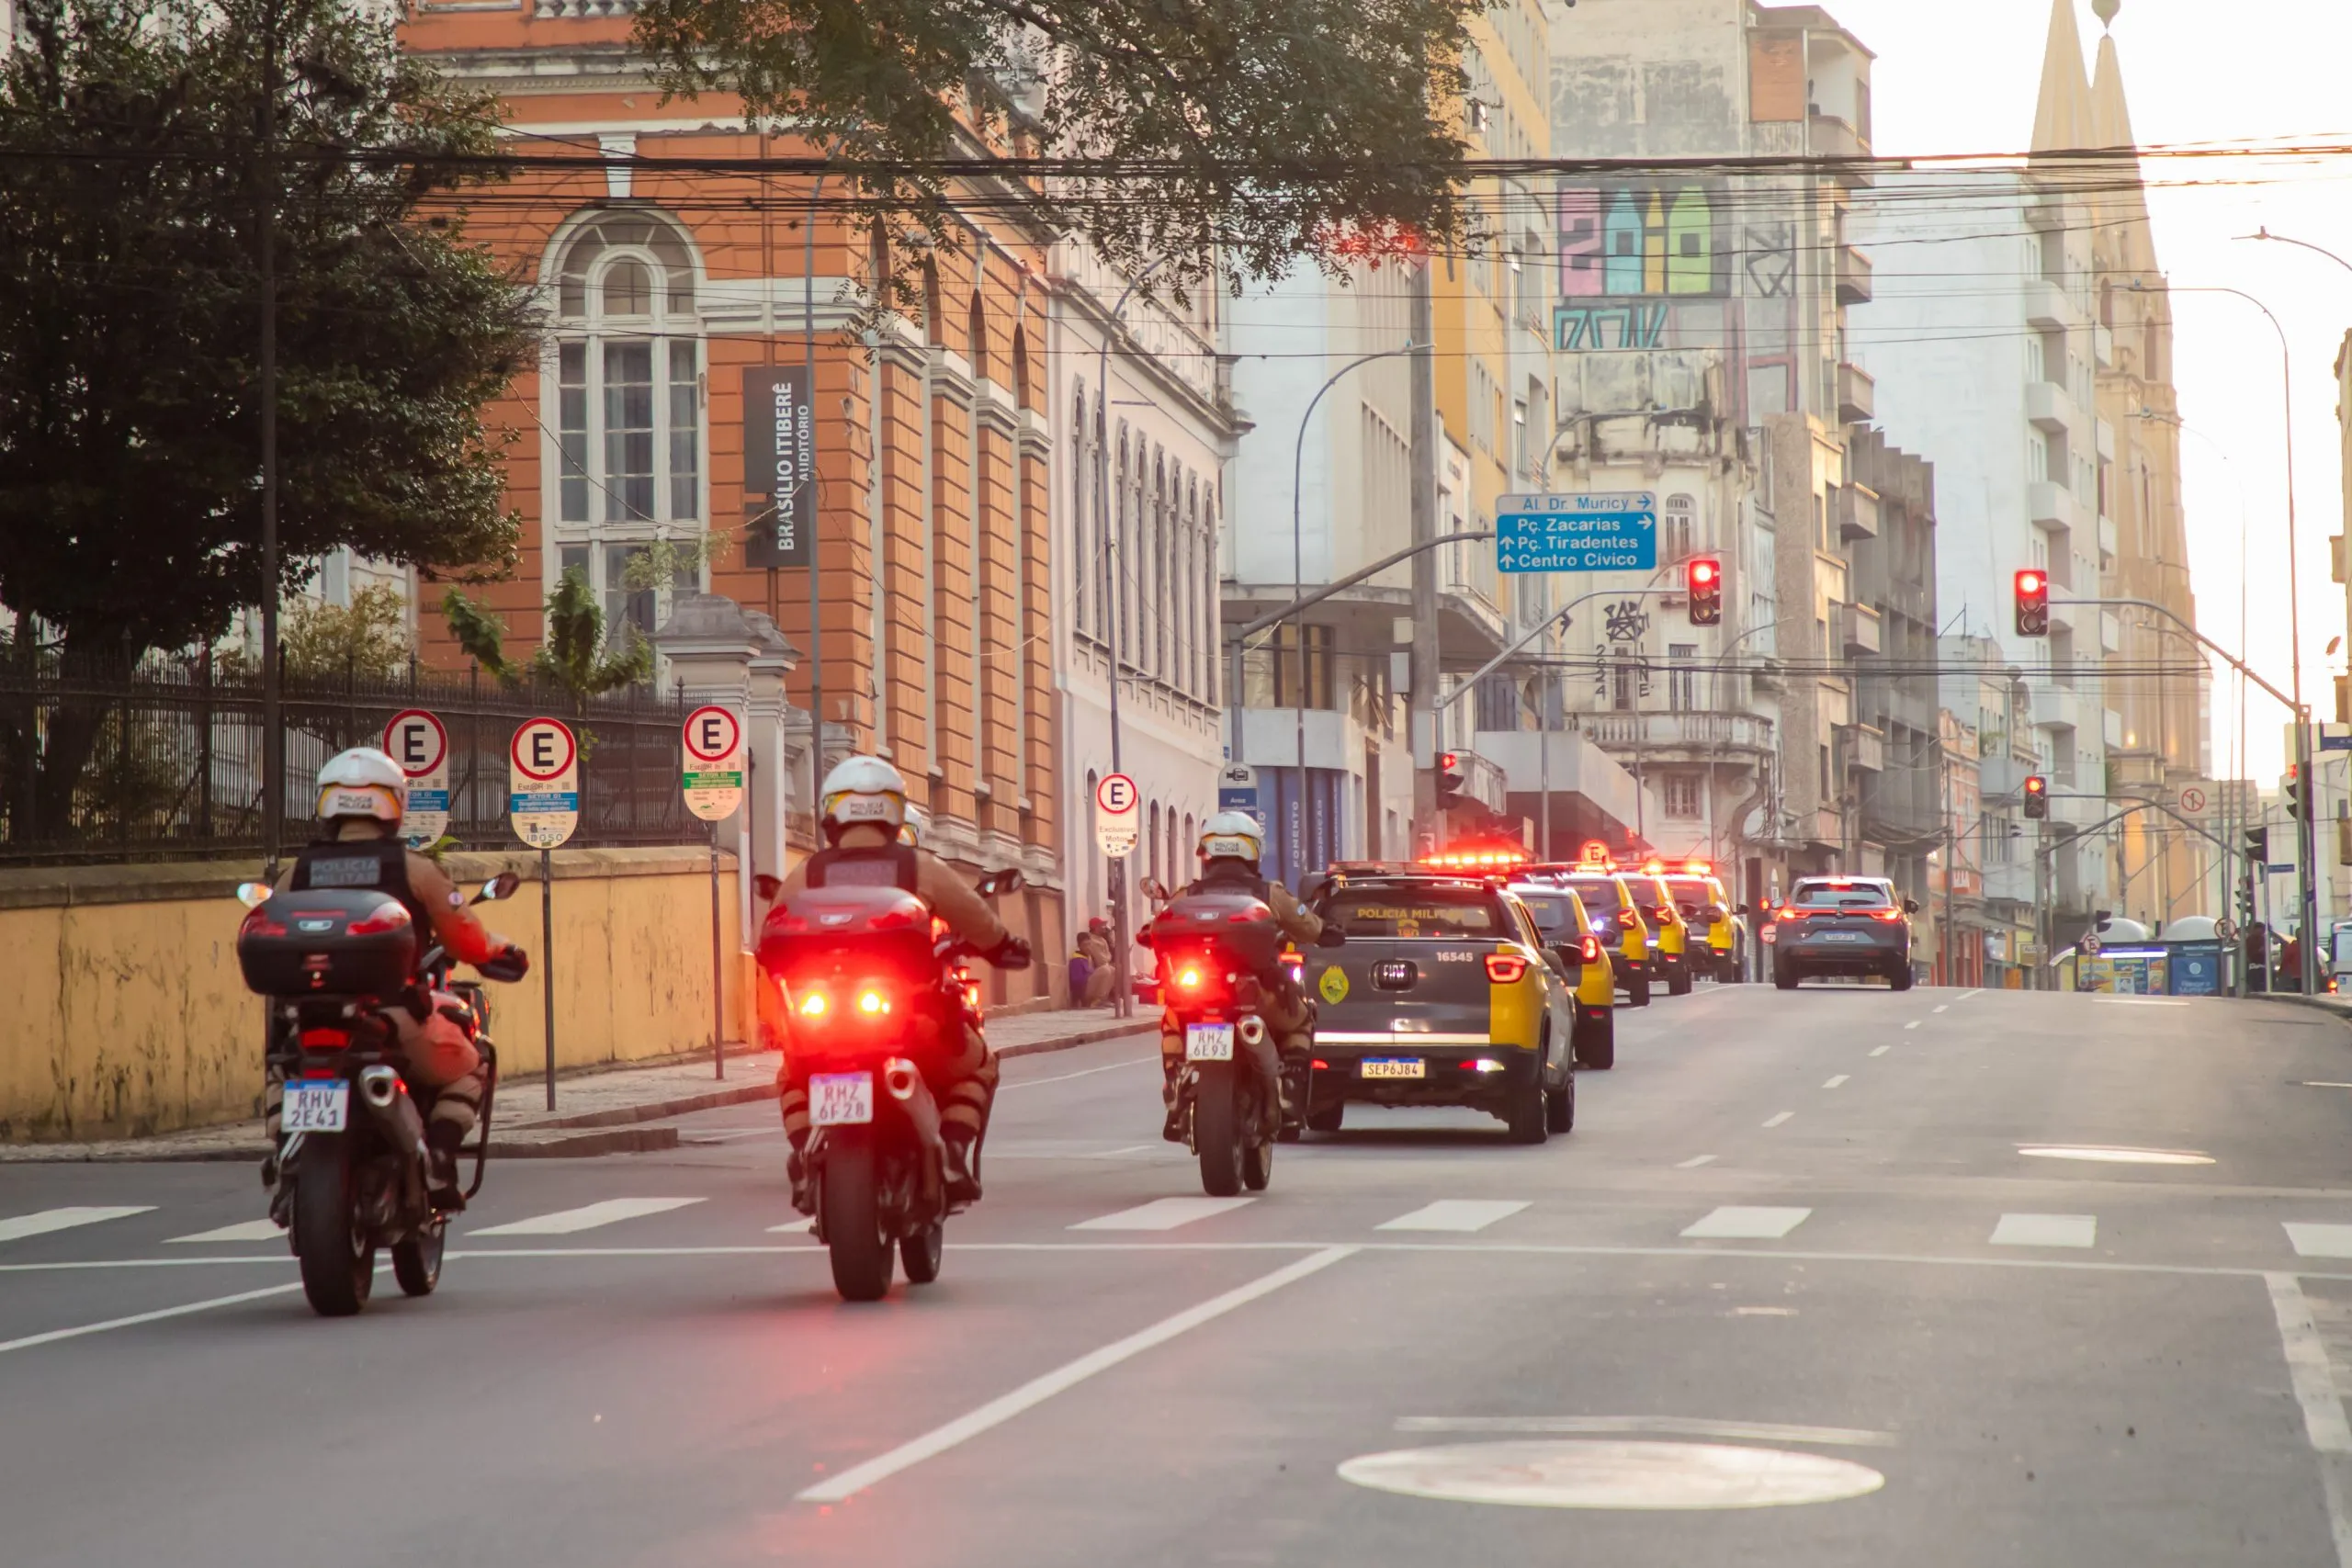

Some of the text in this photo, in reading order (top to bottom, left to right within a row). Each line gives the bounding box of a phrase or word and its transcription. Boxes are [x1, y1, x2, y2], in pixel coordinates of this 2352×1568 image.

[796, 404, 809, 481] AUDITÓRIO
[772, 382, 795, 550] BRASÍLIO ITIBERÊ
[1549, 497, 1568, 511] Dr.
[1577, 497, 1630, 512] Muricy
[1518, 517, 1621, 535] Pç. Zacarias
[1518, 536, 1639, 552] Pç. Tiradentes
[1518, 553, 1637, 568] Centro Cívico
[702, 719, 721, 750] E
[404, 725, 425, 762] E
[532, 732, 554, 767] E
[1111, 783, 1125, 805] E
[526, 833, 563, 842] IDOSO
[1105, 835, 1128, 843] Motos
[1357, 908, 1465, 919] POLICIA MILITAR
[1436, 952, 1474, 963] 16545
[1198, 1032, 1224, 1043] RHZ
[1193, 1044, 1227, 1056] 6E93
[1368, 1064, 1418, 1075] SEP6J84
[299, 1091, 334, 1108] RHV
[825, 1084, 859, 1101] RHZ
[291, 1110, 337, 1127] 2E41
